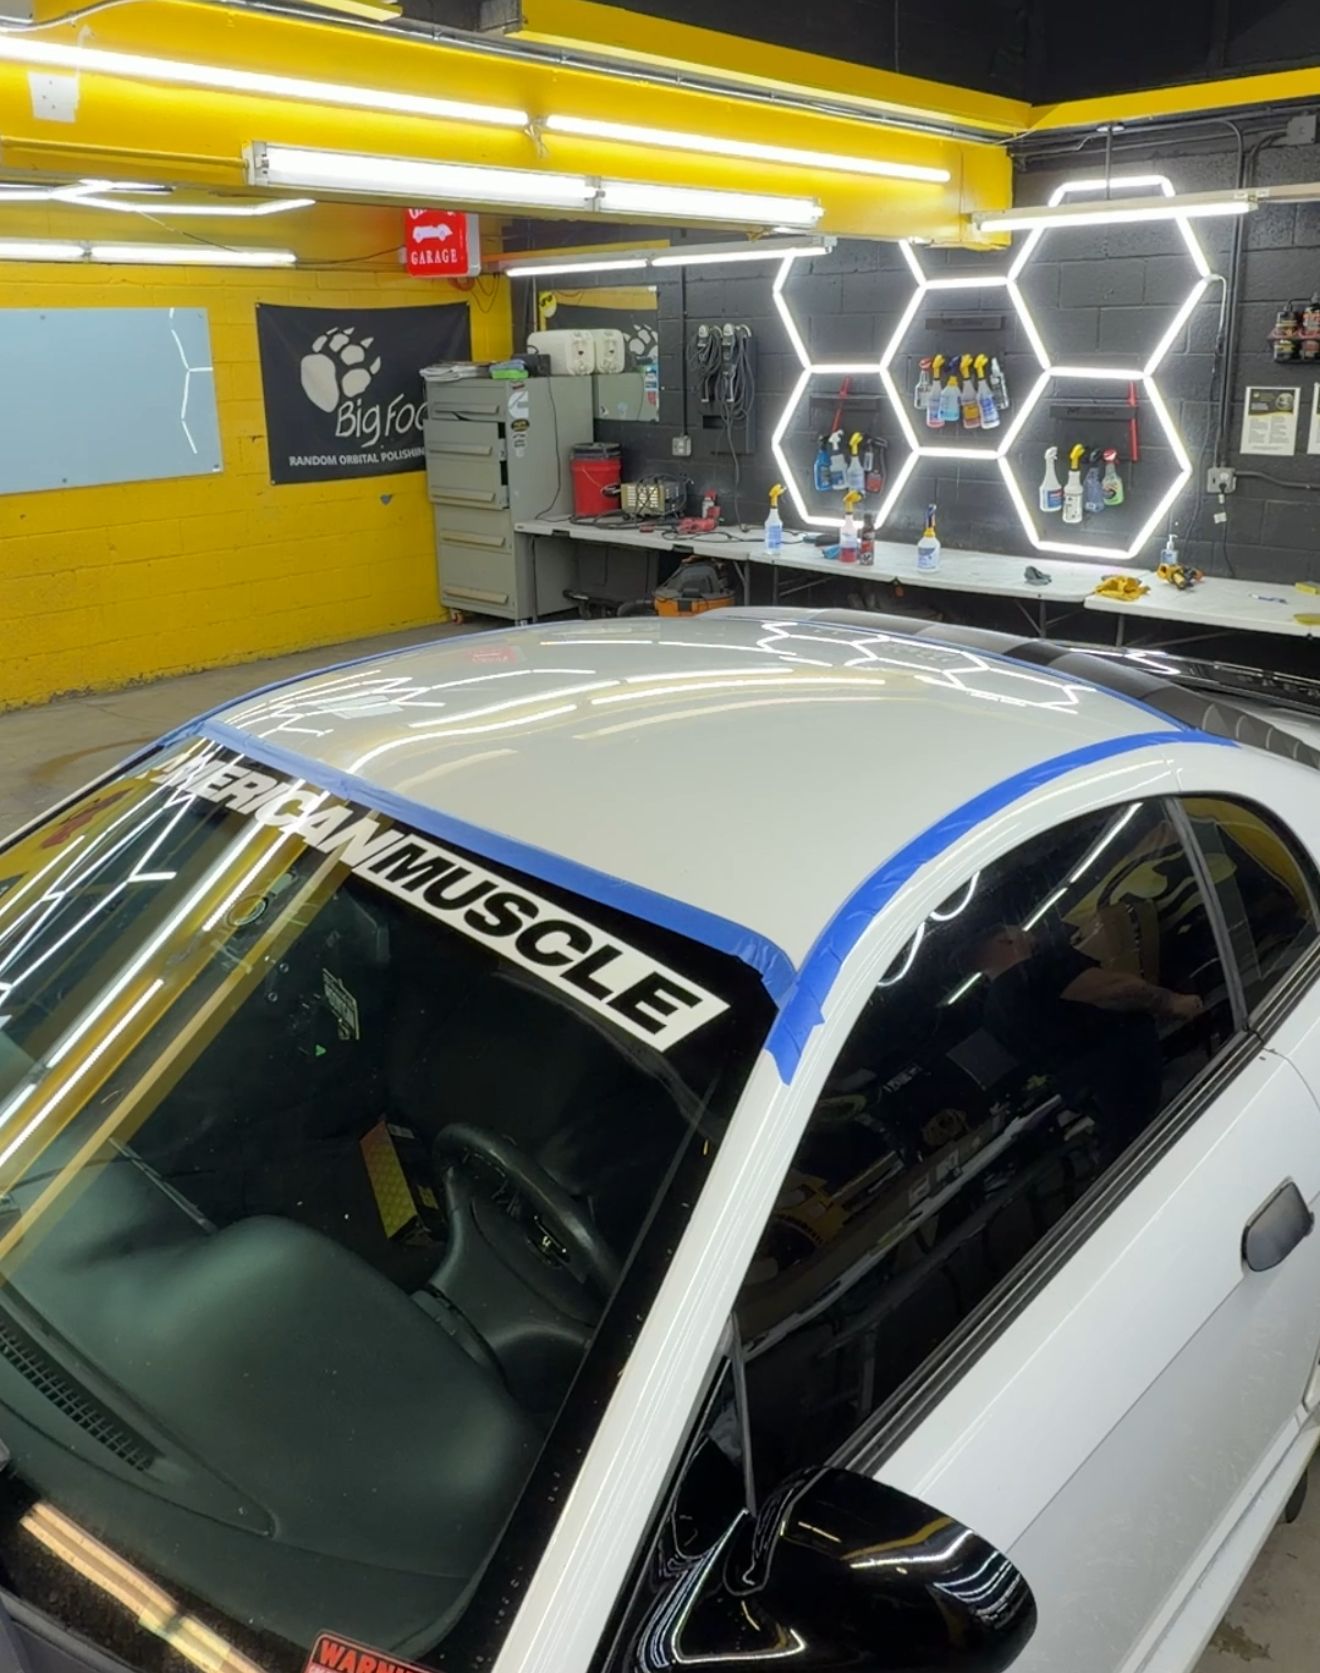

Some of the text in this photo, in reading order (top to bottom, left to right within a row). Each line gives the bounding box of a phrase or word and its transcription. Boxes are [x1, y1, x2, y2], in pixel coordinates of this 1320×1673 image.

[410, 248, 458, 266] GARAGE
[289, 447, 425, 467] RANDOM ORBITAL POLISHIN
